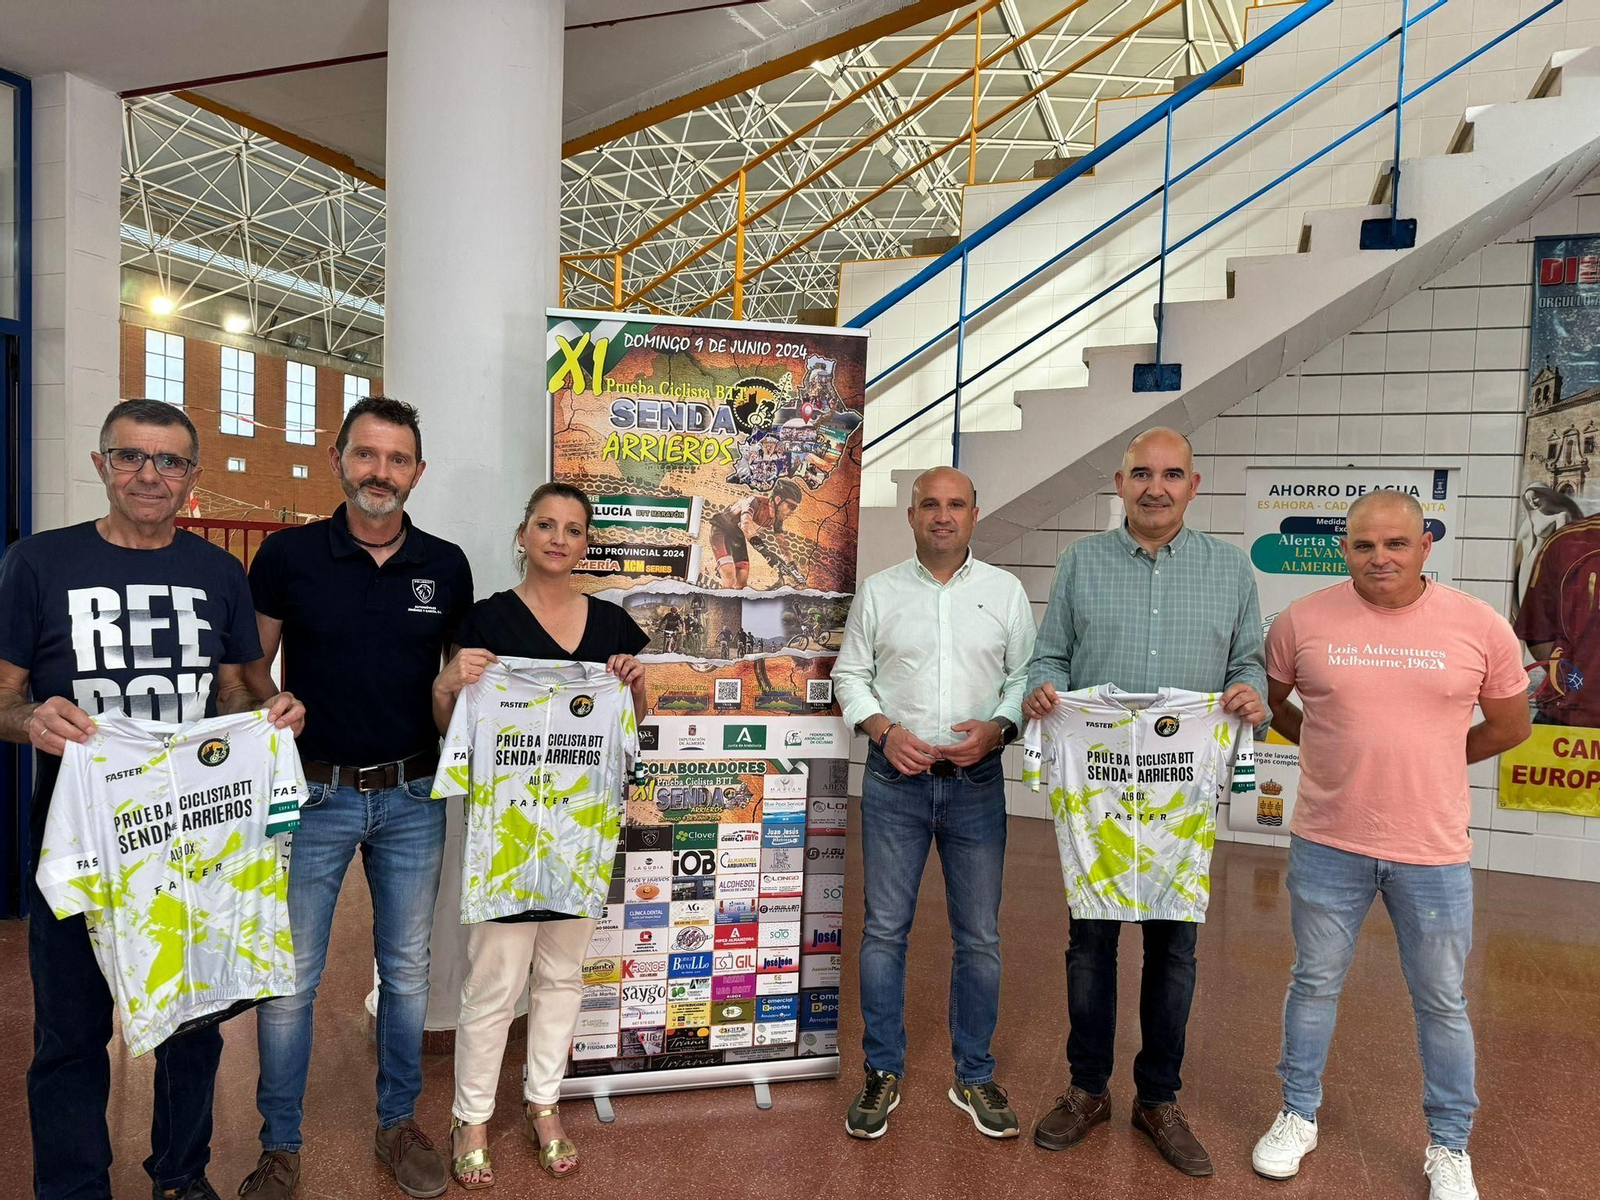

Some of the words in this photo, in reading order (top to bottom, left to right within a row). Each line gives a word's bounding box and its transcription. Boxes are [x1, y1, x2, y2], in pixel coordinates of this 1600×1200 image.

[1540, 255, 1600, 286] DIE
[623, 333, 690, 352] DOMINGO
[695, 336, 704, 353] 9
[709, 338, 727, 353] DE
[730, 340, 771, 356] JUNIO
[775, 343, 808, 360] 2024
[548, 332, 608, 396] XI
[605, 378, 655, 396] Prueba
[659, 381, 711, 399] Ciclista
[715, 385, 748, 401] BTT
[610, 399, 738, 436] SENDA
[602, 431, 734, 465] ARRIEROS
[1269, 485, 1340, 497] AHORRO
[1345, 485, 1366, 497] DE
[1257, 501, 1269, 510] ES
[1272, 501, 1314, 510] AHORA
[1278, 535, 1326, 547] Alerta
[605, 547, 660, 557] PROVINCIAL
[623, 560, 645, 572] XCM
[646, 565, 672, 573] SERIES
[1281, 561, 1347, 573] ALMERIE
[67, 584, 212, 672] REE
[1327, 643, 1358, 654] Lois
[1362, 643, 1446, 659] Adventures
[500, 701, 529, 709] FASTER
[1085, 721, 1113, 729] FASTER
[496, 734, 541, 748] PRUEBA
[548, 733, 587, 748] CICLISTA
[588, 735, 604, 748] BTT
[496, 750, 536, 766] SENDA
[545, 748, 600, 766] ARRIEROS
[1087, 750, 1130, 767] PRUEBA
[1136, 753, 1177, 767] CICLISTA
[1179, 751, 1194, 765] BTT
[105, 767, 143, 784] FASTER
[657, 777, 683, 786] Prueba
[685, 777, 713, 786] Ciclista
[715, 777, 733, 785] BTT
[1087, 765, 1127, 783] SENDA
[1137, 767, 1194, 783] ARRIEROS
[1512, 765, 1600, 790] EUROP
[510, 797, 570, 807] FASTER
[656, 787, 725, 812] SENDA
[1121, 791, 1145, 802] ALBOX
[114, 801, 173, 833] PRUEBA
[179, 787, 231, 811] CICLISTA
[233, 780, 252, 797] BTT
[690, 806, 724, 814] ARRIEROS
[1104, 812, 1167, 821] FASTER
[118, 821, 172, 855] SENDA
[182, 798, 253, 832] ARRIEROS
[783, 827, 799, 835] Jesús
[718, 880, 756, 888] ALCOHESOL
[622, 959, 666, 979] KRONOS
[735, 955, 755, 969] GIL
[622, 984, 666, 1004] saygo
